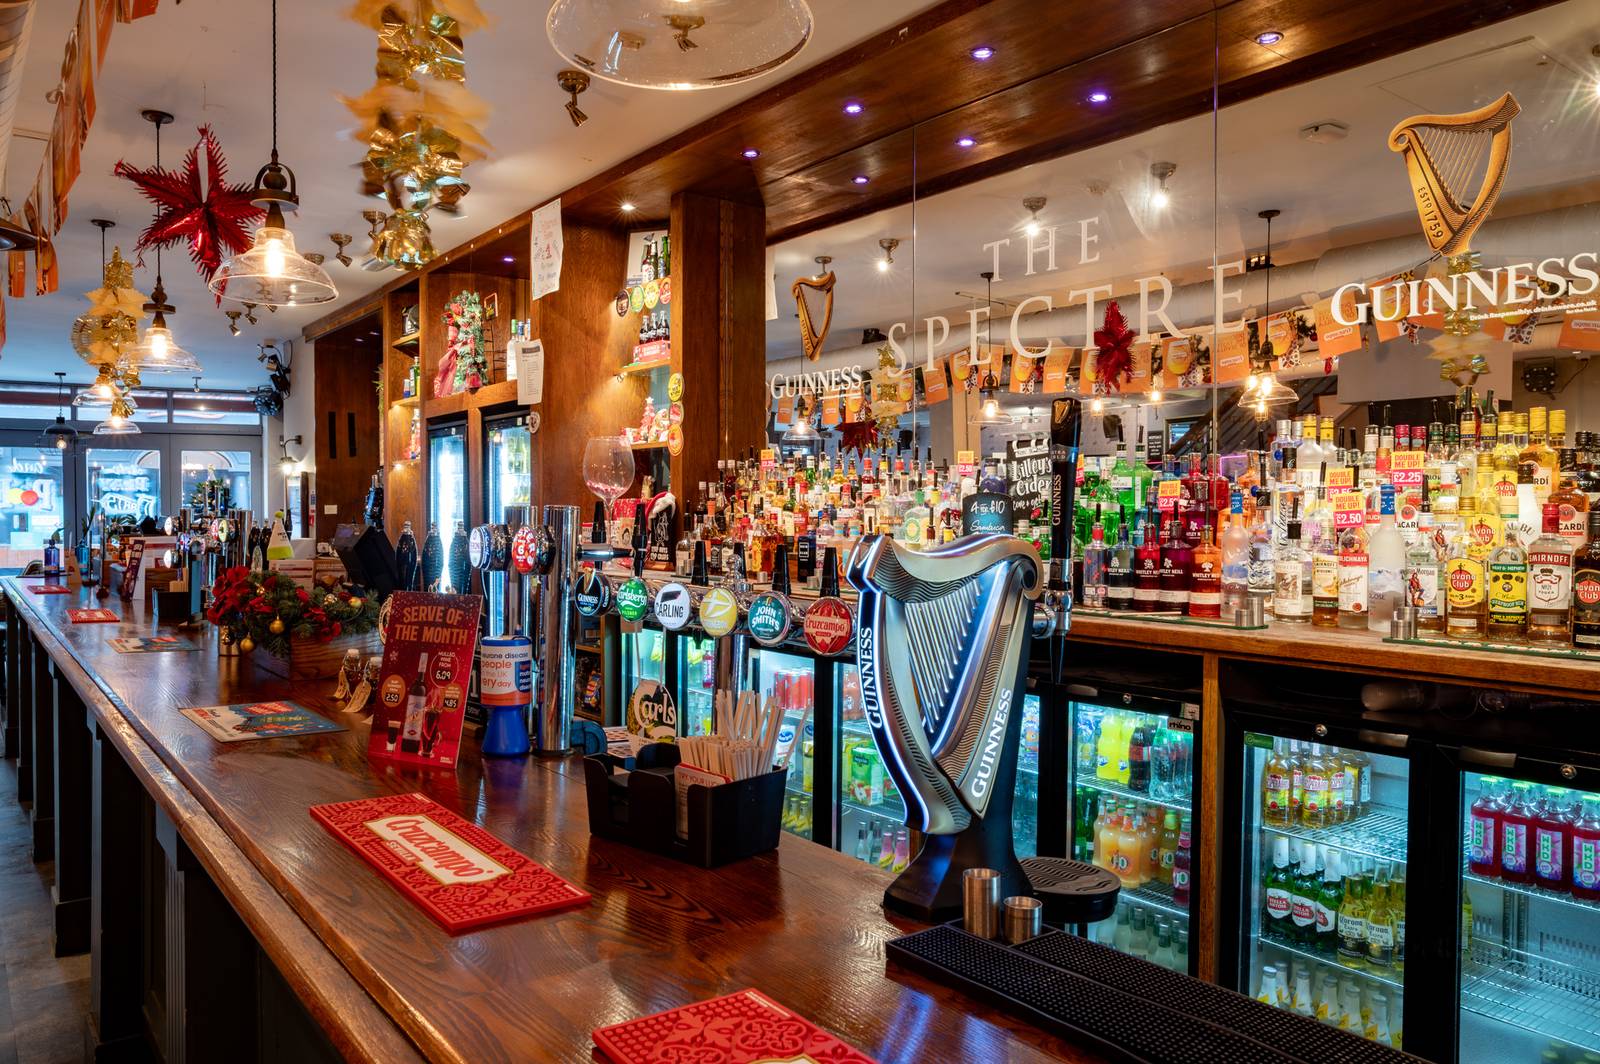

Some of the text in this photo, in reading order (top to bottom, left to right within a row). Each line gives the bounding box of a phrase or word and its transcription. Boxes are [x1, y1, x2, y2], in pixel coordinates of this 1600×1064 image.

[1425, 209, 1444, 240] 1759
[983, 217, 1100, 283] THE
[1330, 252, 1600, 326] GUINNESS
[887, 259, 1247, 379] SPECTRE
[771, 365, 862, 399] GUINNESS
[1011, 456, 1052, 481] Lilley's
[1393, 472, 1421, 482] £2.25
[1016, 475, 1052, 496] Cider
[1051, 474, 1061, 525] GUINNESS
[1335, 513, 1362, 524] £2.50
[1558, 521, 1585, 531] CARDÍ
[1529, 553, 1568, 564] SMIRNOFF
[1452, 580, 1470, 588] Club
[577, 593, 599, 604] GUINNESS
[1579, 592, 1599, 600] Club
[403, 605, 464, 625] SERVE OF
[655, 602, 684, 618] CARLING
[755, 606, 776, 617] JOHN
[751, 617, 780, 631] SMITH'S
[805, 621, 845, 632] Cruzcampo
[394, 624, 469, 646] THE MONTH
[860, 626, 883, 729] GUINNESS
[1168, 720, 1192, 732] rhino
[972, 688, 1012, 799] GUINNESS
[386, 818, 487, 878] Cruzcampo
[1339, 916, 1364, 926] Corona
